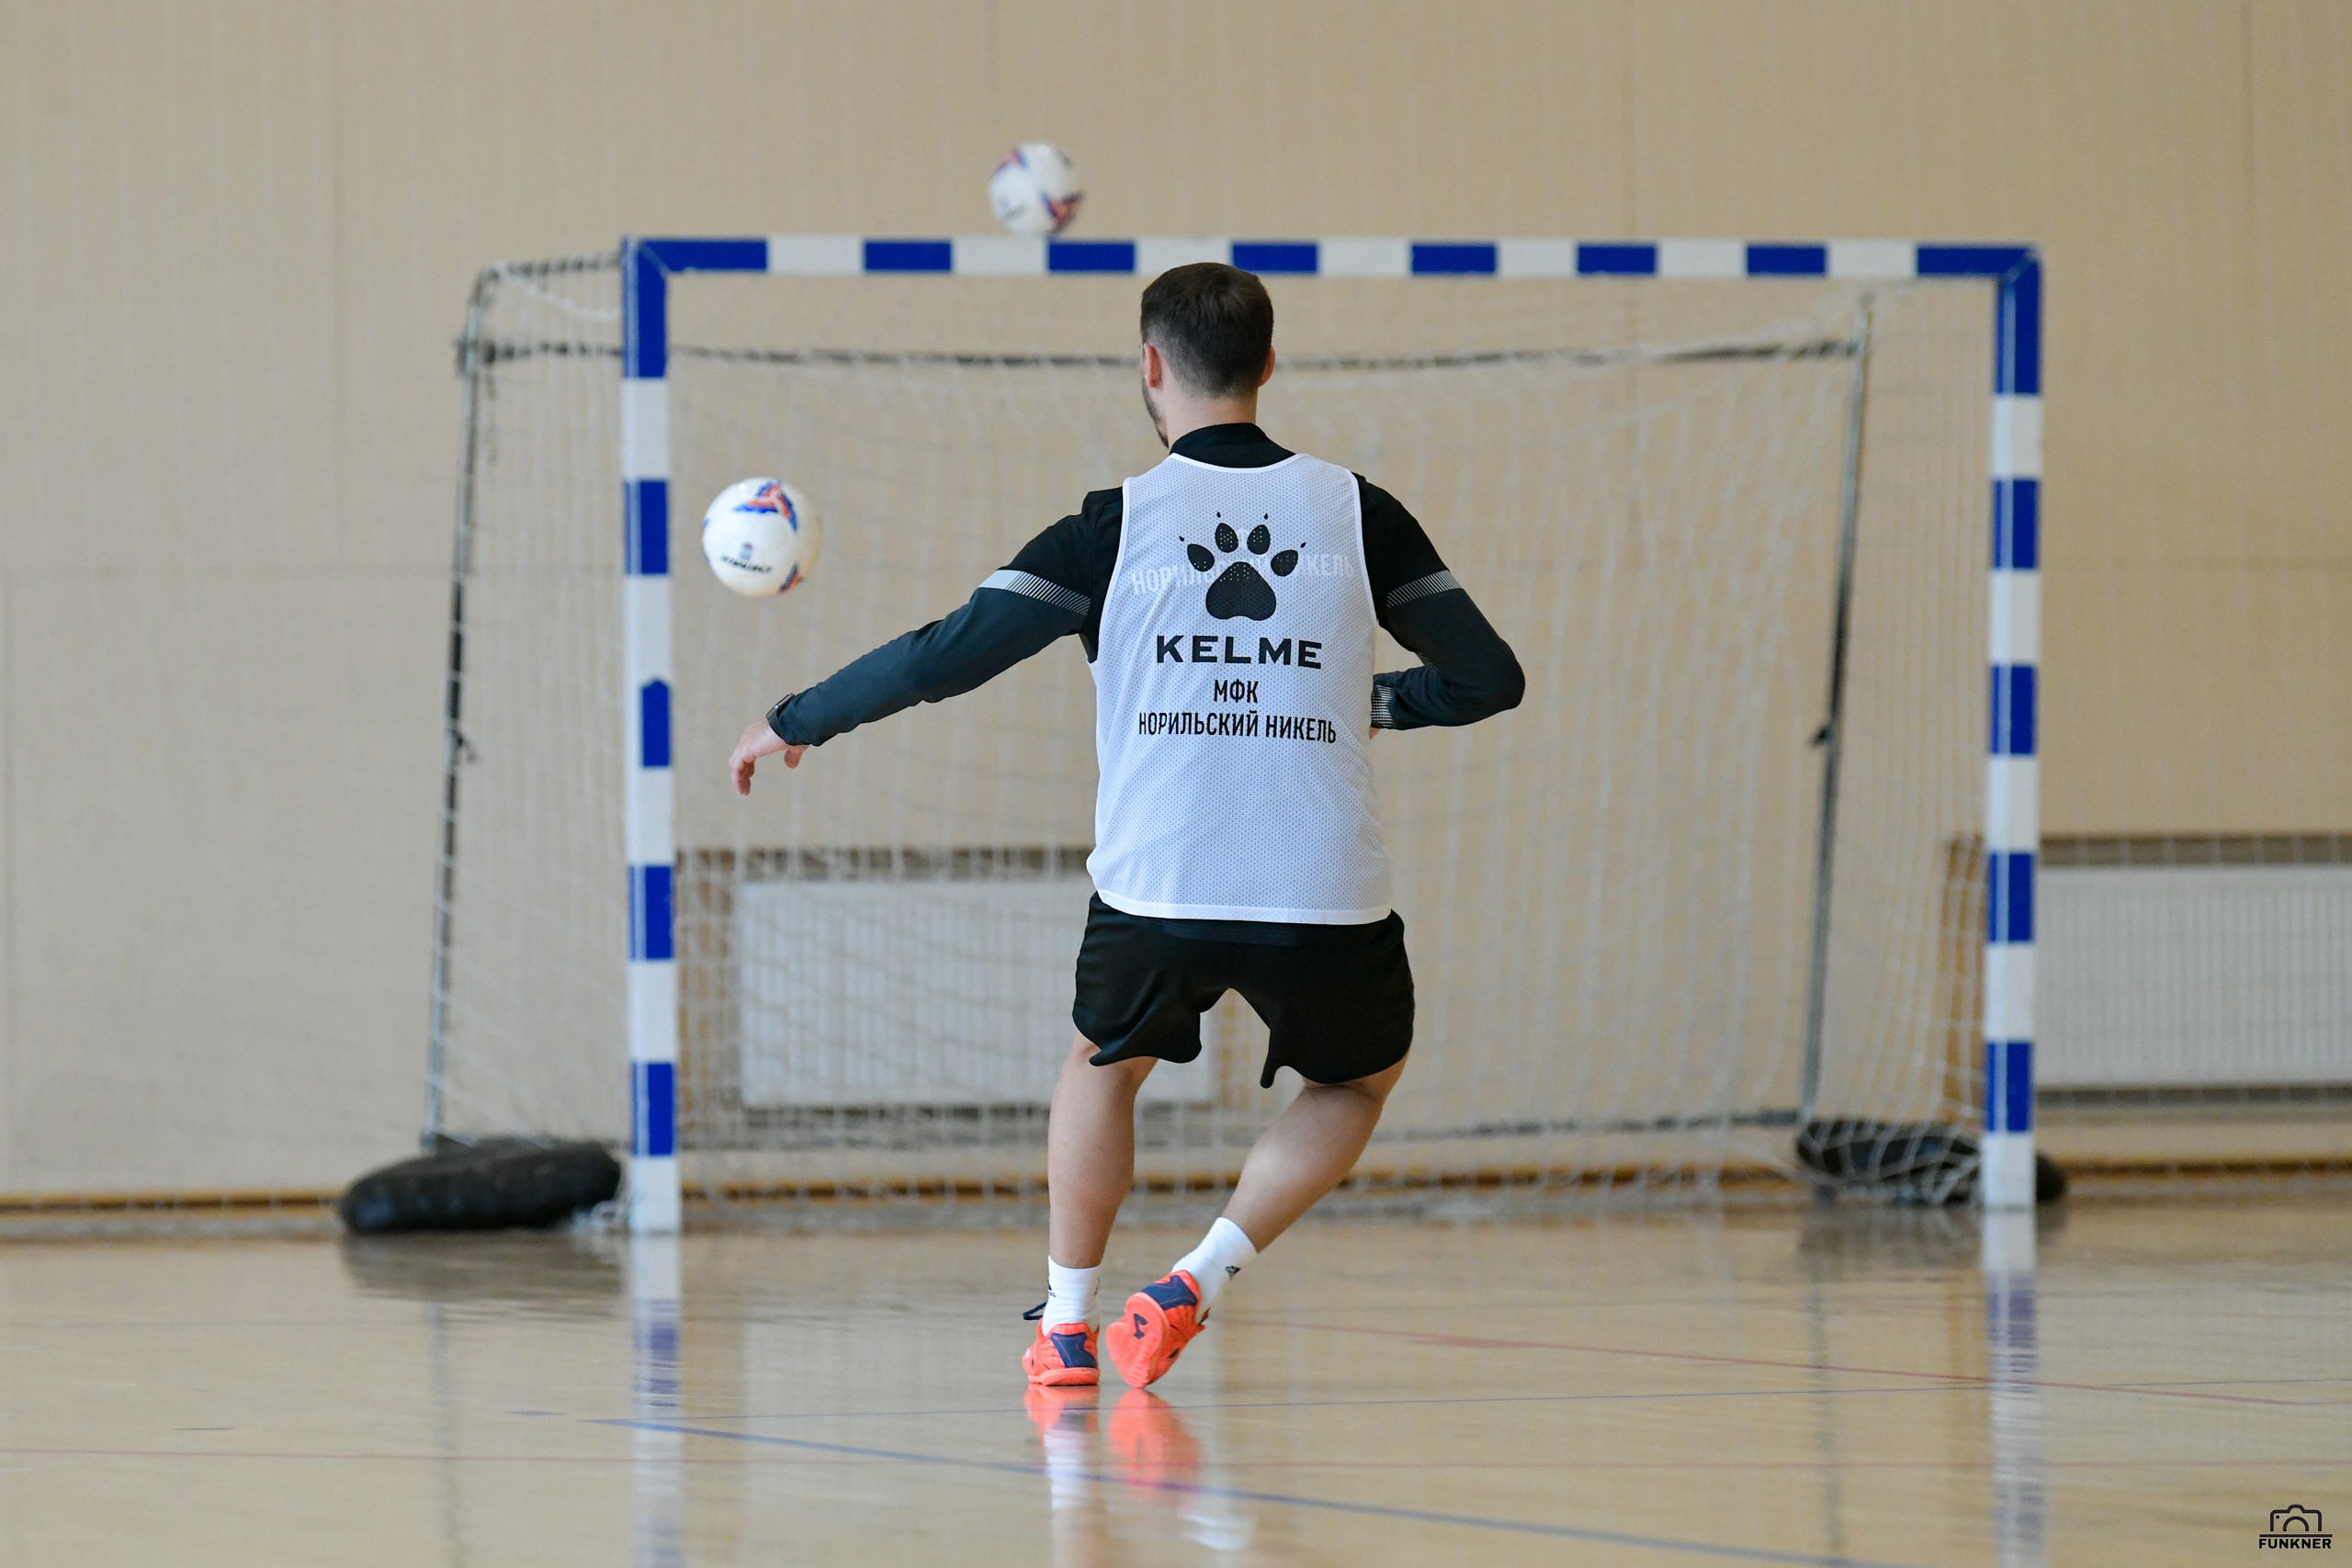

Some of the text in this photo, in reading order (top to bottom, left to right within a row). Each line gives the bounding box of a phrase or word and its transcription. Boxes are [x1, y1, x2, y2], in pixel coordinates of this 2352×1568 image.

[1157, 635, 1322, 670] KELME
[1214, 679, 1259, 703] МФК
[1138, 709, 1337, 744] НОРИЛЬСКИЙ НИКЕЛЬ
